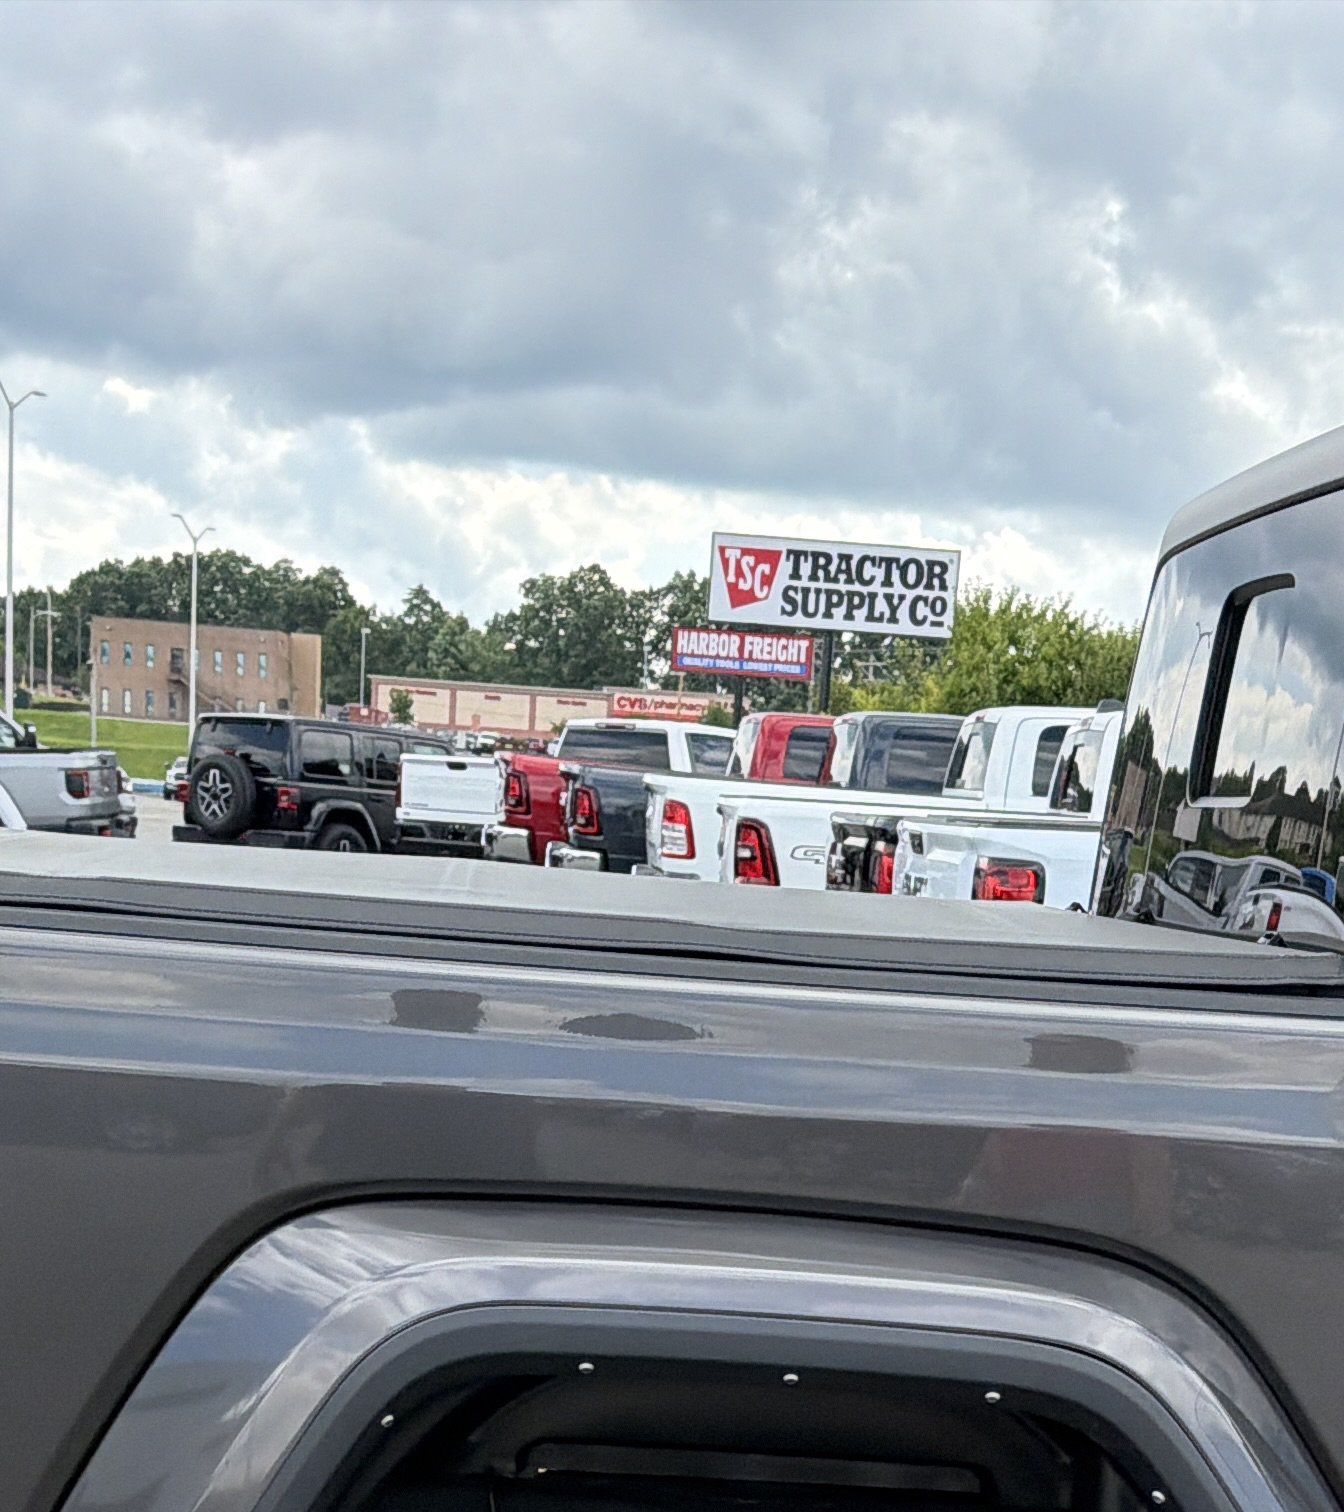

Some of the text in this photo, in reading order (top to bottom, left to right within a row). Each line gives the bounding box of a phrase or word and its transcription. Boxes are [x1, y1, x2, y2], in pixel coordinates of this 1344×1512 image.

[724, 548, 770, 599] TSC
[786, 548, 949, 592] TRACTOR
[780, 585, 907, 624] SUPPLY
[677, 630, 810, 664] HARBOR FREIGHT
